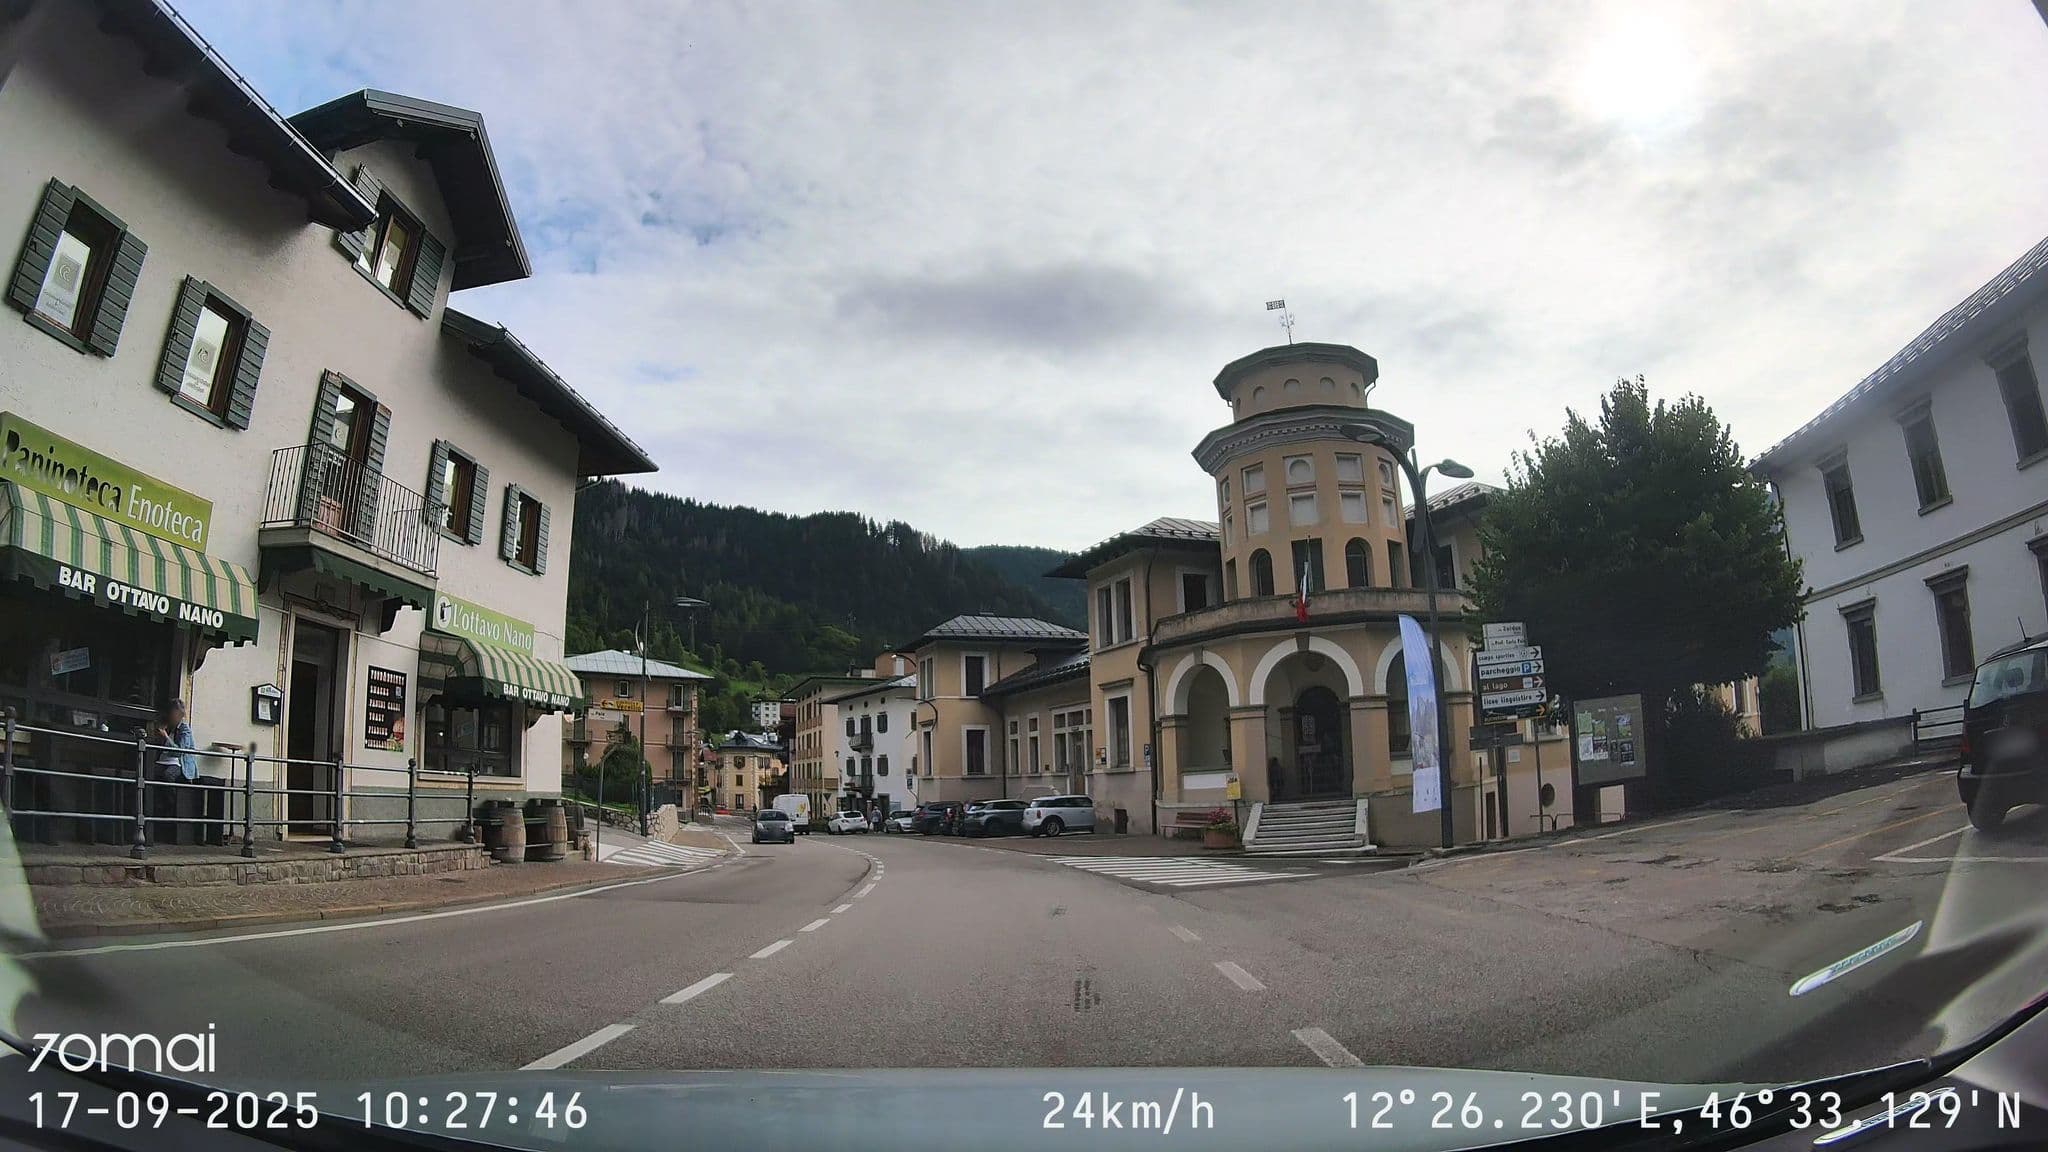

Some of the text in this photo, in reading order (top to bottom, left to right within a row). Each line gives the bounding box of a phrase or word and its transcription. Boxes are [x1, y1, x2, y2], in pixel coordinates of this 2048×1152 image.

[2, 429, 203, 544] Paninoteca Enoteca
[59, 565, 224, 629] BAR OTTAVO NANO
[453, 603, 532, 650] L'ottavo Nano
[1480, 664, 1521, 677] parcheggio
[503, 683, 570, 707] BAR OTTAVO NANO
